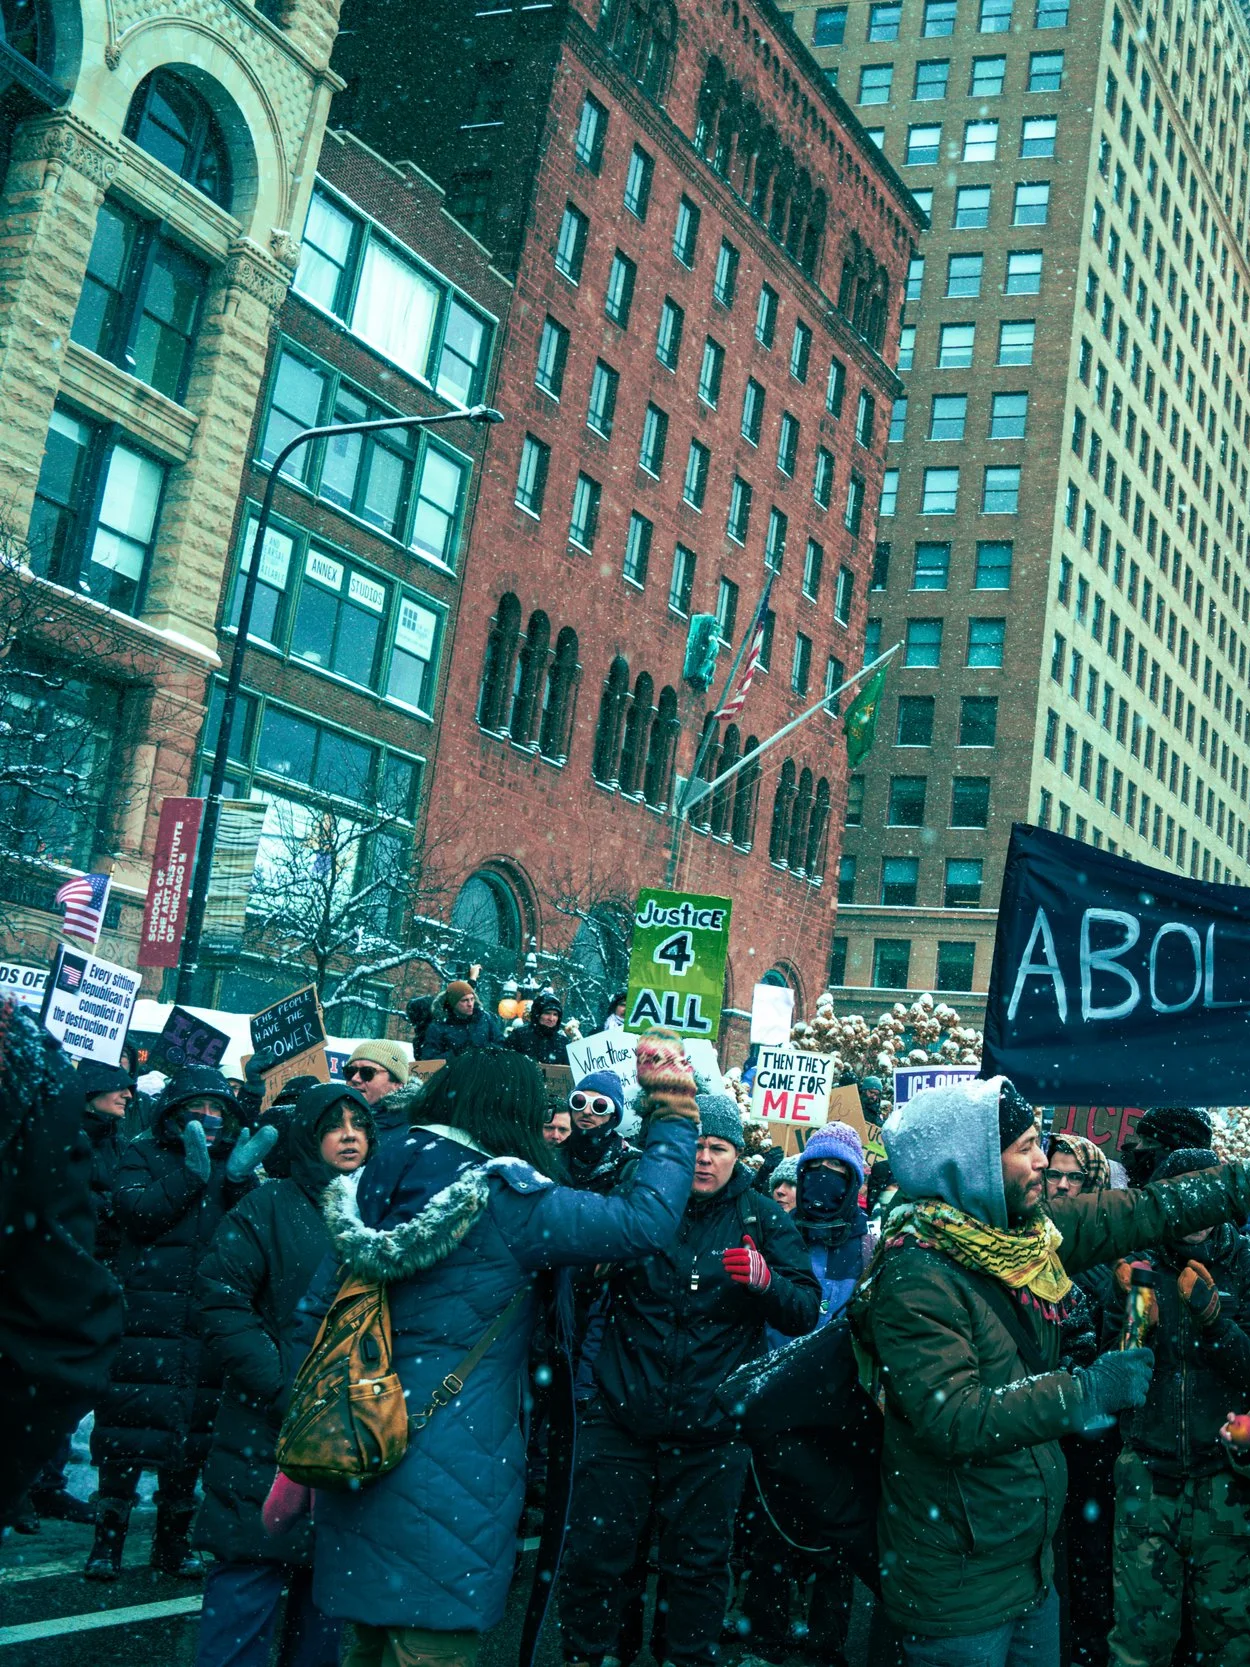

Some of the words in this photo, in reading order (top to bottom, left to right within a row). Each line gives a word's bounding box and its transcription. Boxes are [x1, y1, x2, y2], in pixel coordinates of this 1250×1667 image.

[311, 558, 338, 583] ANNEX
[350, 578, 383, 606] STUDIOS
[166, 821, 184, 886] INSTITUTE
[148, 890, 163, 942] SCHOOL
[156, 869, 165, 887] OF
[161, 888, 172, 915] ART
[169, 866, 185, 922] CHICAGO
[157, 916, 168, 942] THE
[166, 925, 176, 943] OF
[655, 932, 694, 975] 4
[81, 979, 123, 1006] Republican
[123, 994, 131, 1009] is
[89, 964, 112, 985] Every
[112, 973, 135, 994] sitting
[53, 1006, 65, 1021] the
[65, 1011, 108, 1037] destruction
[109, 1027, 118, 1041] of
[79, 998, 116, 1022] complicit
[117, 1010, 124, 1024] in
[253, 1012, 273, 1027] THE
[630, 990, 711, 1031] ALL
[63, 1028, 94, 1051] America.
[164, 1014, 223, 1066] ICE
[254, 1022, 281, 1043] HAVE
[285, 1010, 304, 1025] THE
[606, 1040, 632, 1066] those
[763, 1052, 794, 1070] THEN
[796, 1055, 830, 1075] THEY
[757, 1071, 795, 1091] CAME
[799, 1076, 826, 1095] FOR
[907, 1075, 931, 1099] ICE
[762, 1090, 815, 1122] ME
